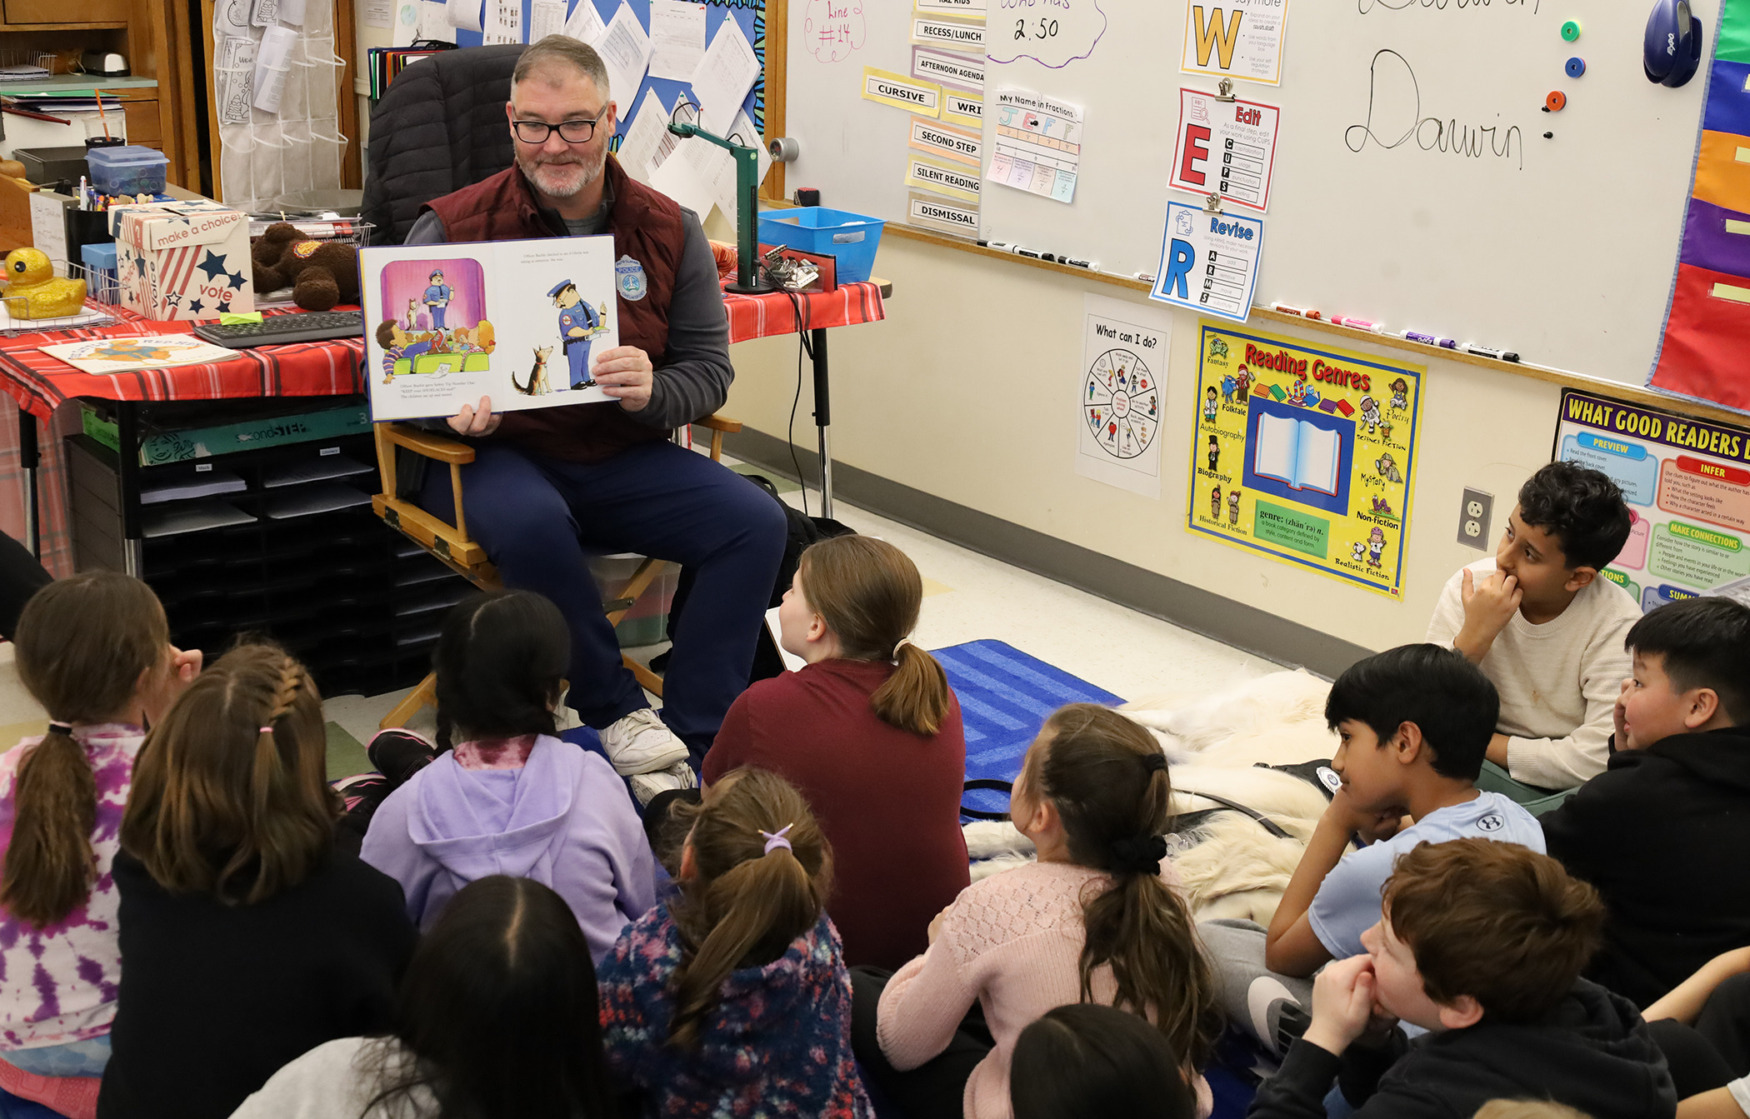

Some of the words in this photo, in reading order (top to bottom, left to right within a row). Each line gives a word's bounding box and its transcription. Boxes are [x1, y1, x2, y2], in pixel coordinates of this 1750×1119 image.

[828, 0, 849, 19] Line
[923, 26, 982, 41] RECESS/LUNCH
[1014, 18, 1058, 41] 2:50
[1192, 5, 1243, 70] W
[920, 60, 958, 75] AFTERNOON
[959, 69, 984, 81] AGENDA
[878, 84, 925, 102] CURSIVE
[999, 94, 1013, 105] My
[1014, 96, 1037, 107] Name
[1037, 99, 1044, 109] in
[1045, 102, 1074, 118] Fractions
[1235, 106, 1262, 127] Edit
[921, 130, 954, 147] SECOND
[956, 141, 977, 153] STEP
[1179, 123, 1212, 186] E
[917, 167, 944, 181] SILENT
[944, 174, 980, 191] READING
[921, 205, 975, 225] DISMISSAL
[157, 228, 189, 246] make
[191, 227, 199, 235] a
[201, 213, 241, 232] choice!
[1210, 216, 1254, 241] Revise
[1161, 237, 1196, 300] R
[199, 284, 233, 301] vote
[1096, 323, 1117, 339] What
[1119, 332, 1132, 343] can
[1135, 333, 1140, 345] I
[1142, 336, 1157, 349] do?
[1207, 356, 1229, 369] Fantasy
[1245, 343, 1308, 381] Reading
[1312, 359, 1372, 391] Genres
[1222, 403, 1246, 417] Folktale
[1200, 423, 1246, 443] Autobiography
[1568, 398, 1613, 428] WHAT
[1615, 409, 1662, 439] GOOD
[1665, 421, 1740, 458] READERS
[1593, 438, 1629, 454] PREVIEW
[1197, 467, 1232, 484] Biography
[1700, 463, 1726, 478] INFER
[1361, 472, 1386, 491] Mystery
[1199, 514, 1227, 530] Historical
[1227, 524, 1248, 536] Fiction
[1259, 510, 1284, 525] genre:
[1356, 510, 1399, 530] Non-fiction
[1265, 520, 1279, 529] book
[1279, 525, 1296, 536] category
[1296, 528, 1313, 539] defined
[1277, 533, 1293, 542] content
[1294, 536, 1303, 545] and
[1670, 523, 1690, 536] MAKE
[1690, 529, 1739, 549] CONNECTIONS
[1335, 558, 1364, 573] Realistic
[1366, 567, 1389, 581] Fiction
